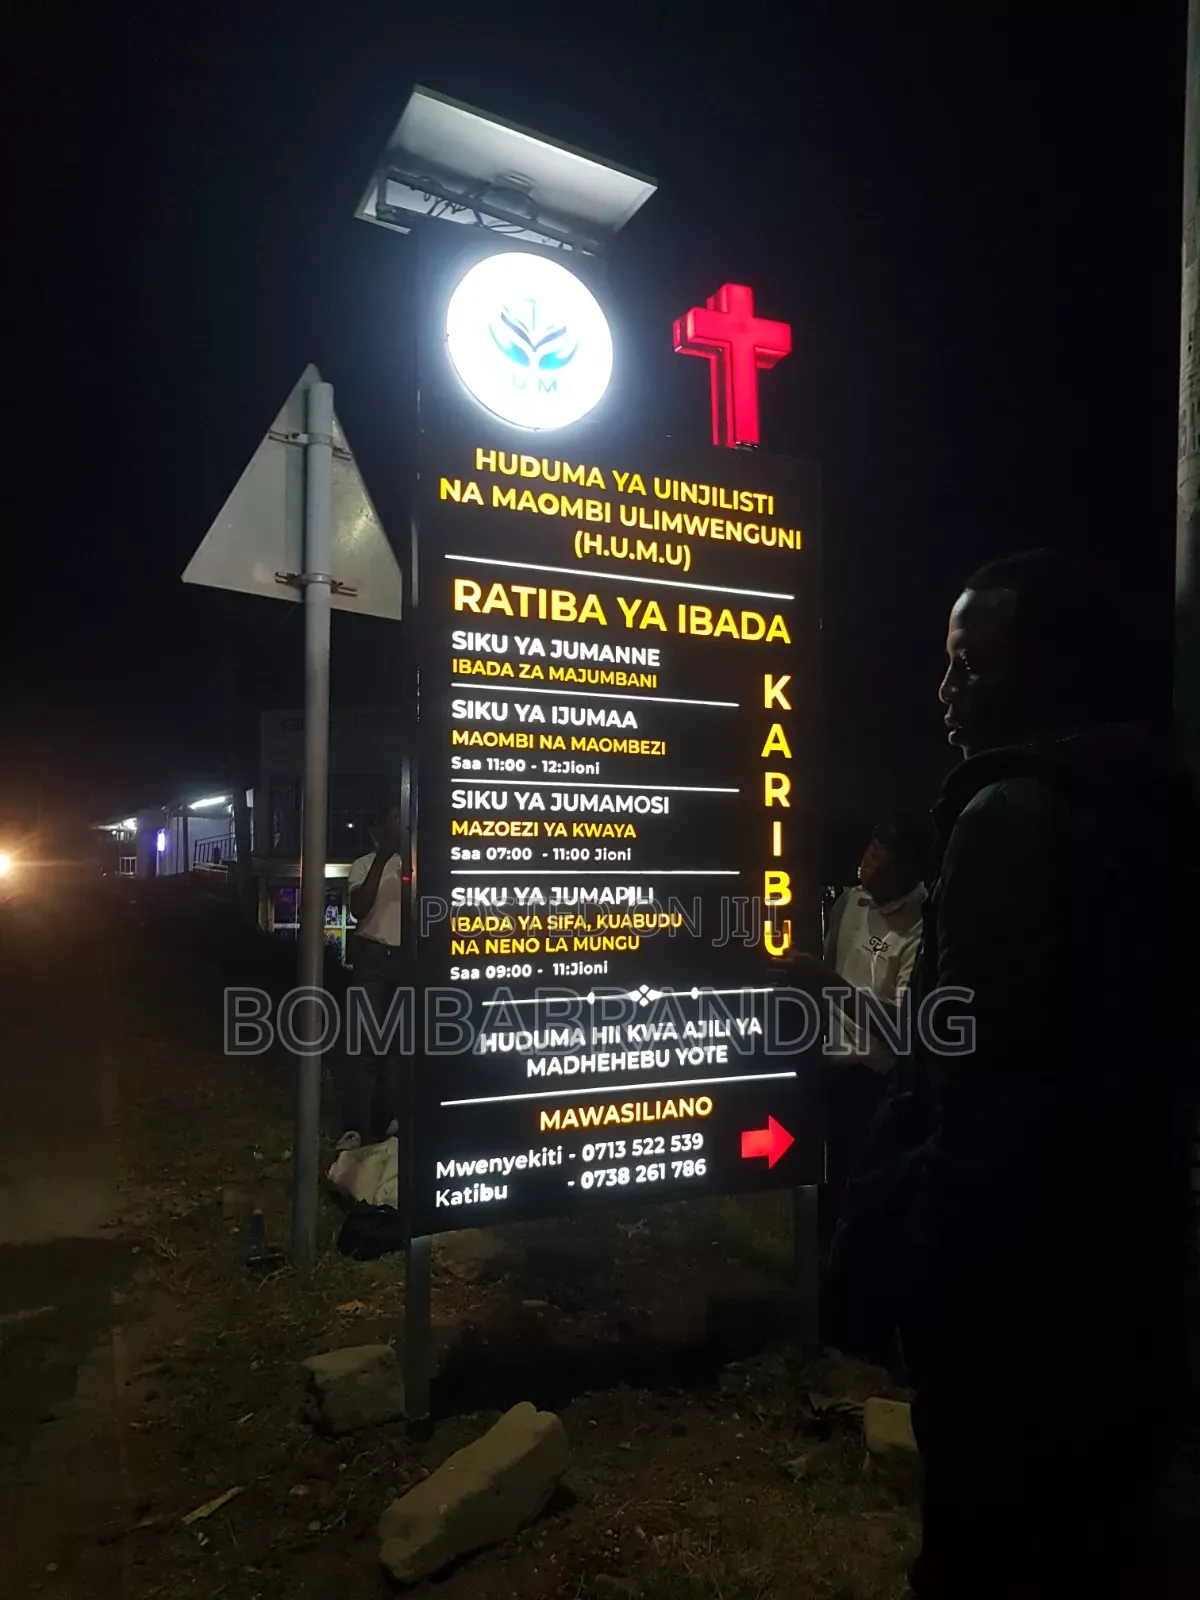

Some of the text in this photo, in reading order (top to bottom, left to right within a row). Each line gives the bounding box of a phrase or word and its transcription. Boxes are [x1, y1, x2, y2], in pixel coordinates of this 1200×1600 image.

[476, 448, 774, 515] HUDUMA YA UINJILISTI
[439, 478, 801, 549] NA MAOMBI ULIMWENGUNI
[575, 531, 691, 571] (H.U.M.U)
[454, 578, 791, 644] RATIBA YA IBADA
[452, 631, 660, 667] SIKU YA JUMANNE
[452, 659, 657, 688] IBADA ZA MAJUMBANI
[452, 700, 638, 728] SIKU YA IJUMAA
[452, 730, 666, 755] MAOMBI NA MAOMBEZI
[451, 757, 481, 770] Saa
[487, 758, 526, 772] 11:00
[542, 760, 600, 774] 12:Jioni
[451, 790, 669, 814] SIKU YA JUMAMOSI
[452, 821, 636, 838] MAZOEZI YA KWAYA
[451, 848, 480, 860] Saa
[486, 848, 532, 860] 07:00
[553, 848, 590, 861] 11:00
[594, 848, 631, 861] Jioni
[451, 886, 654, 906] SIKU YA JUMAPILI
[452, 913, 682, 932] IBADA YA SIFA, KUABUDU
[451, 935, 640, 956] NA NENO LA MUNGU
[450, 967, 480, 980] Saa
[486, 964, 532, 978] 09:00
[553, 961, 608, 976] 11:Jioni
[480, 1018, 762, 1052] HUDUMA HII KWA AJILI YA
[527, 1046, 728, 1077] MADHEHEBU YOTE
[540, 1097, 713, 1131] MAWASILIANO
[436, 1146, 562, 1179] Mwenyekiti
[582, 1142, 627, 1162] 0713
[632, 1137, 665, 1157] 522
[671, 1133, 703, 1151] 539
[436, 1184, 508, 1208] Katibu
[581, 1167, 629, 1188] 0738
[636, 1163, 666, 1182] 261
[671, 1159, 706, 1179] 786
